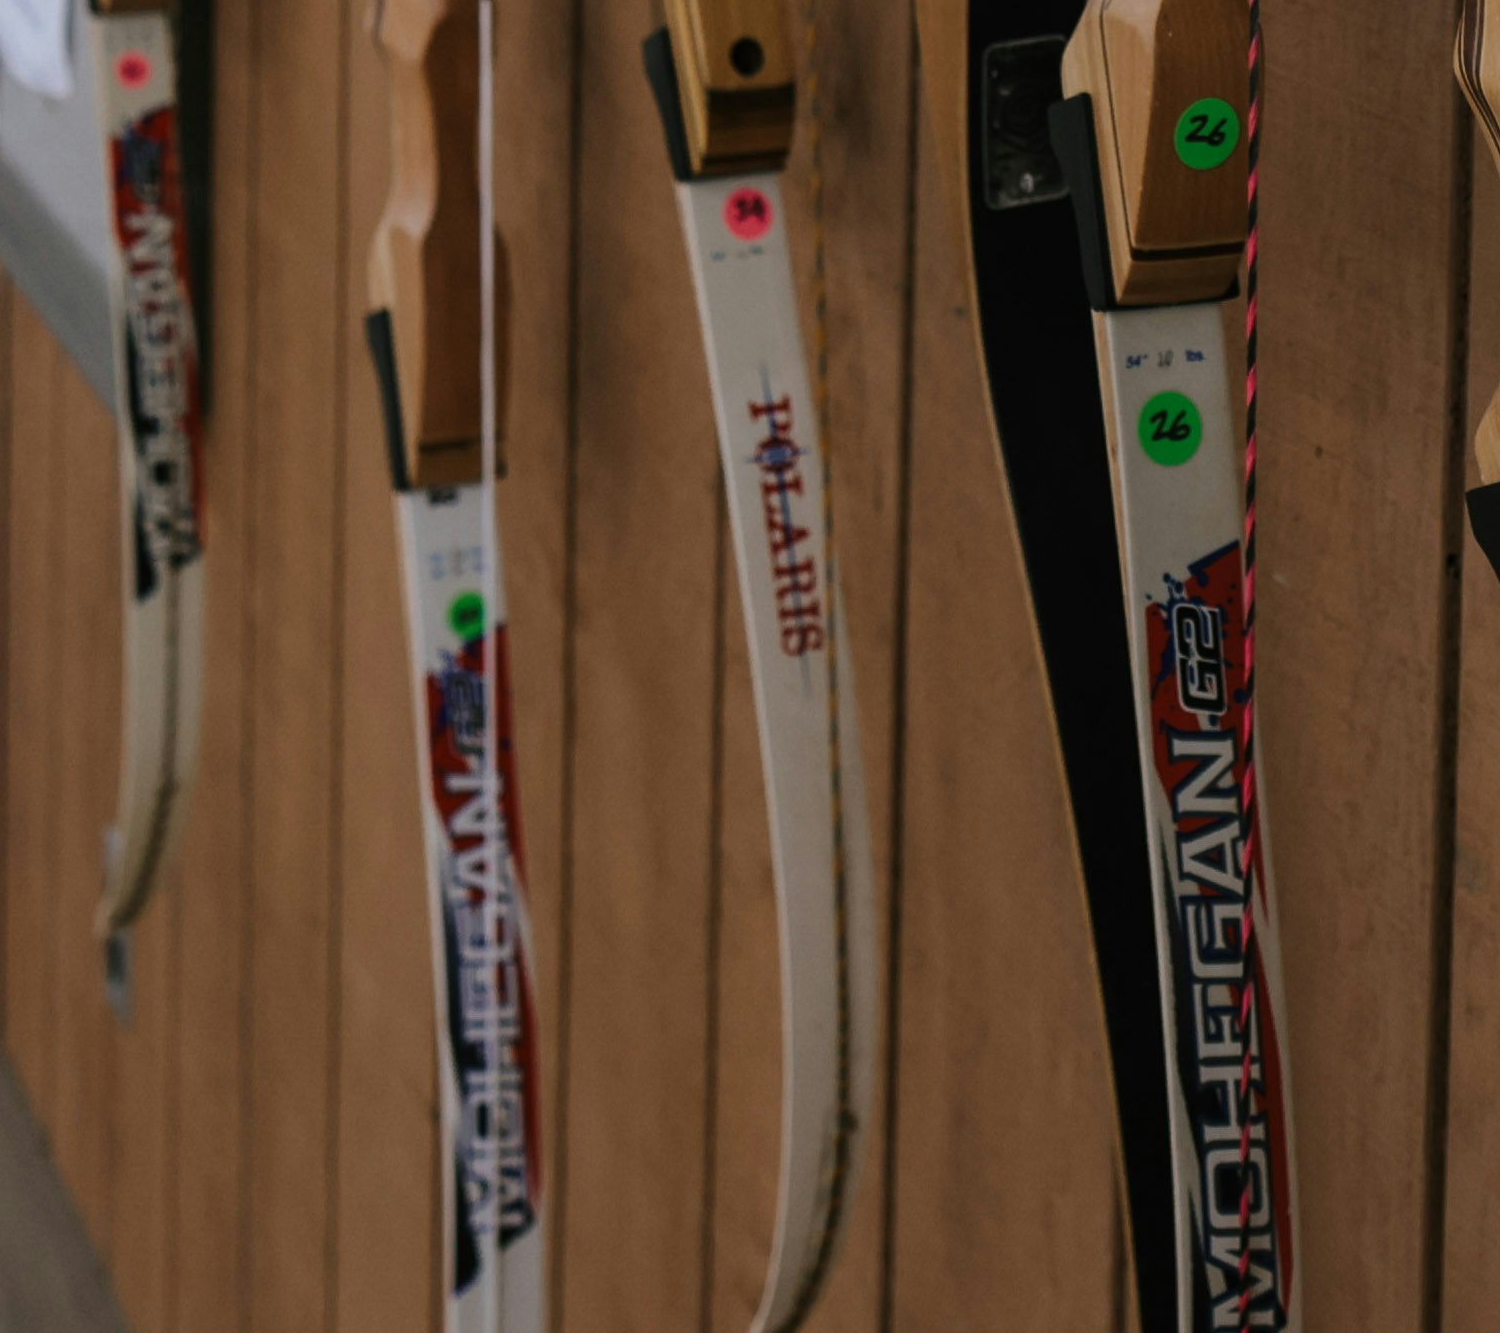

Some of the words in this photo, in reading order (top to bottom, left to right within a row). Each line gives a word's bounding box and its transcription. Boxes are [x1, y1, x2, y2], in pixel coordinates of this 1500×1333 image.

[1184, 114, 1228, 147] 26
[1148, 409, 1193, 442] 26
[747, 392, 825, 658] POLARIS
[1173, 603, 1229, 716] G2
[1168, 736, 1277, 1329] MOHEGAN
